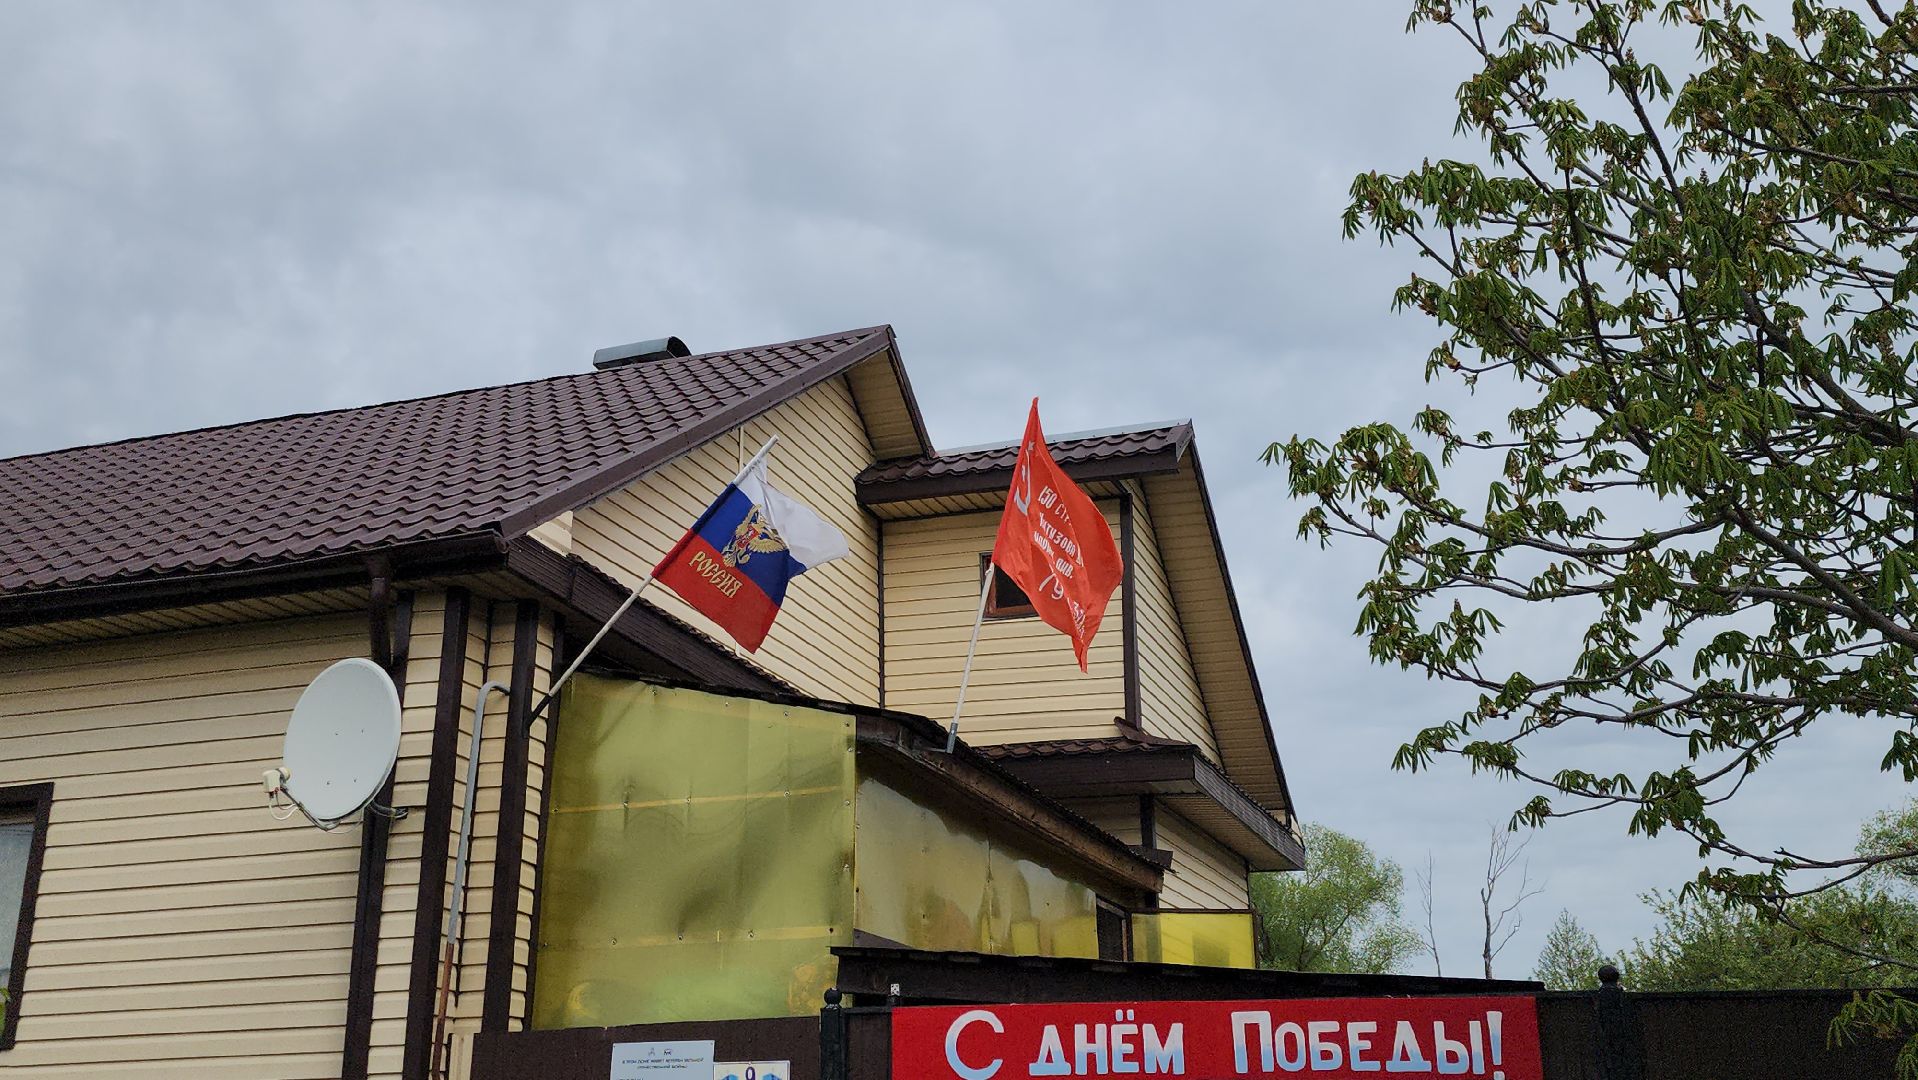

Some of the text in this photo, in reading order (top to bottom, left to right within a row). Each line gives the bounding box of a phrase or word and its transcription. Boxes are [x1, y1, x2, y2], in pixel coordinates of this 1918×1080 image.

[1038, 485, 1058, 510] 150
[688, 550, 743, 598] РОССИЯ
[945, 1009, 1505, 1080] С ДНЁМ ПОБЕДЫ!
